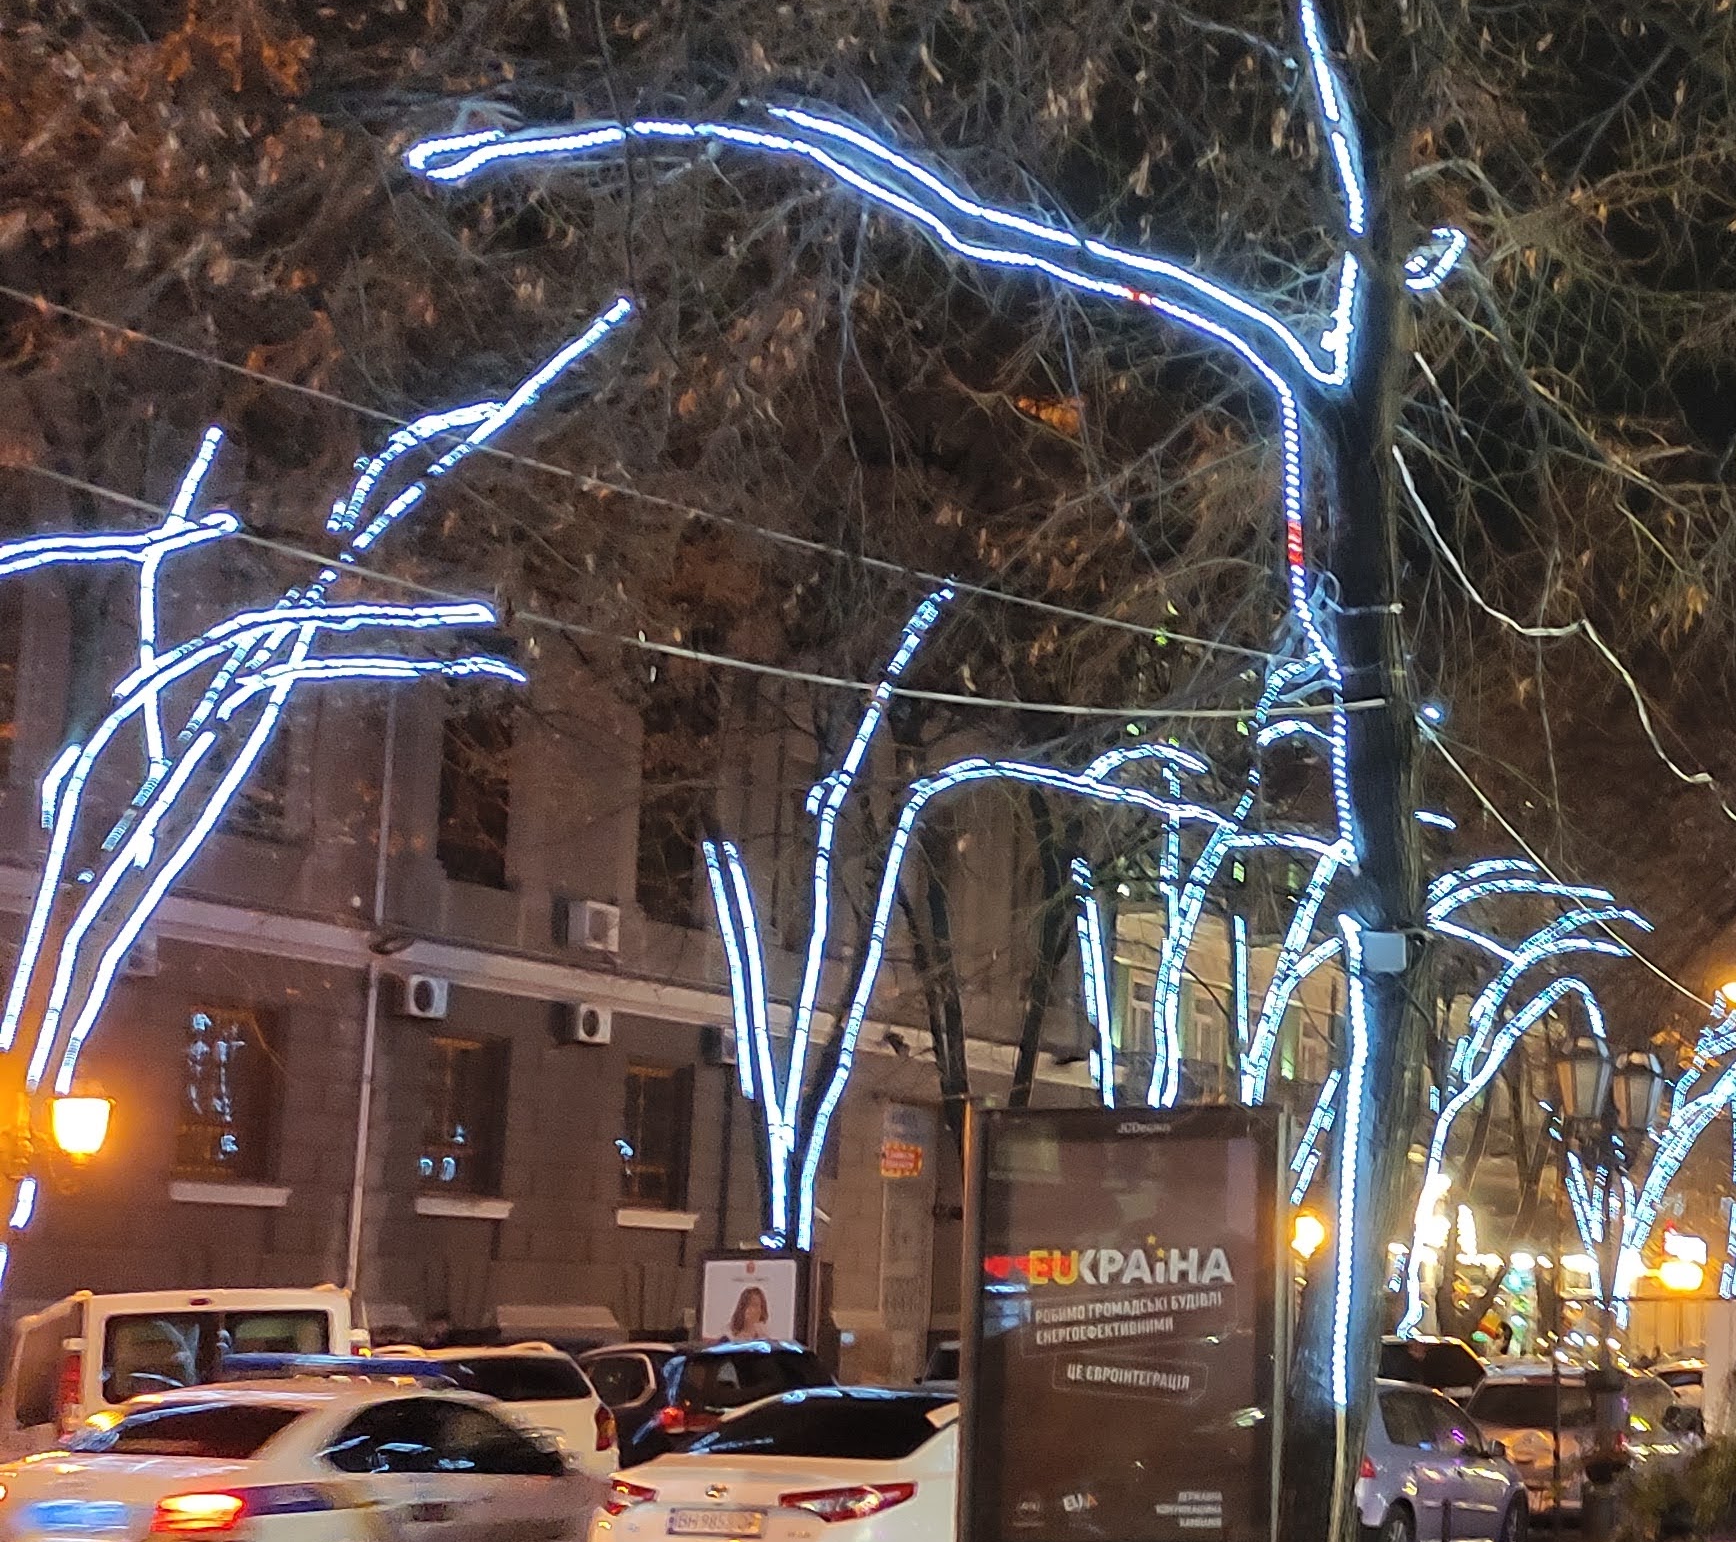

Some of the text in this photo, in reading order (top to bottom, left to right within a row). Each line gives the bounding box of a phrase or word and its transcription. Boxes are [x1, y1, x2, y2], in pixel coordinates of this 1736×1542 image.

[1035, 1290, 1223, 1324] РОБИМО ГРОМАДСЬКІ БУДІВЛІ
[1066, 1363, 1084, 1381] ЦЕ
